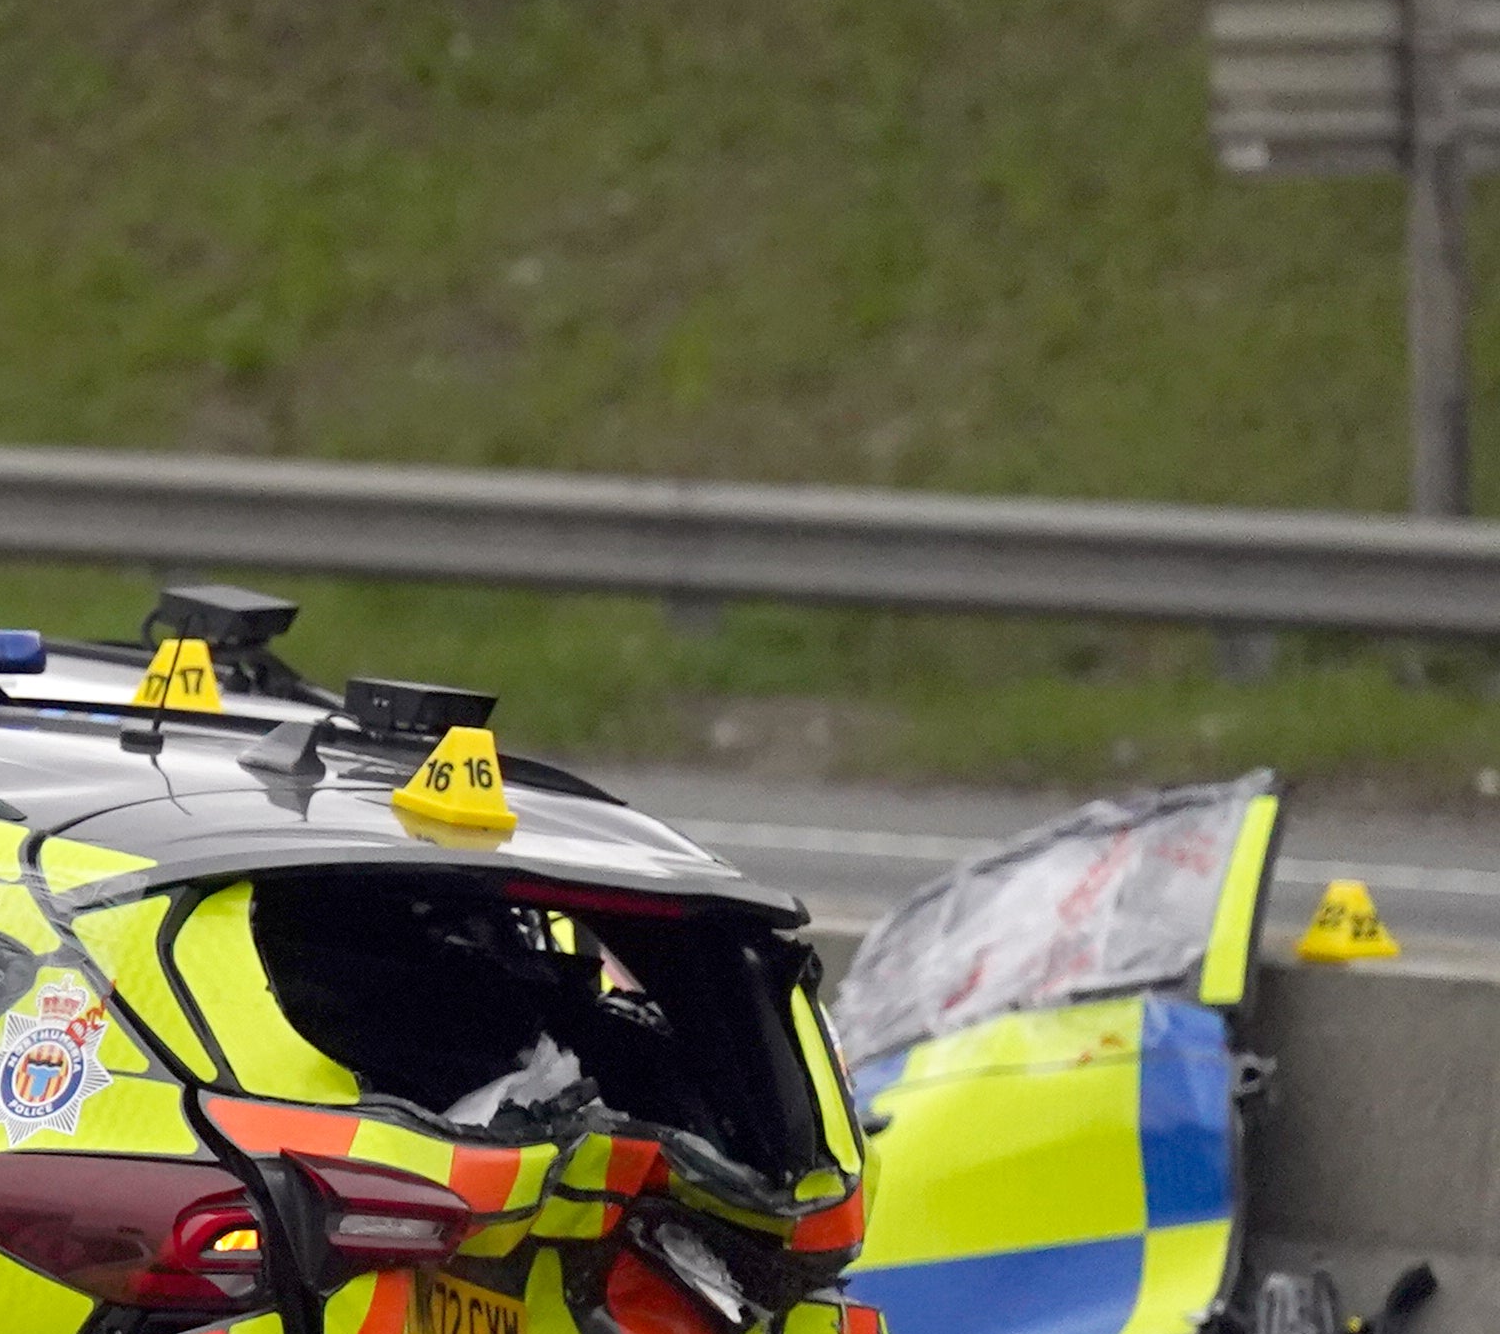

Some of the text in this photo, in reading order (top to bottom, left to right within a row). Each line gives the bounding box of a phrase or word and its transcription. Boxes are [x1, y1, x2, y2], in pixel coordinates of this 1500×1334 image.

[175, 667, 204, 696] 17
[425, 757, 493, 792] 16 16
[7, 1101, 54, 1116] POLICE
